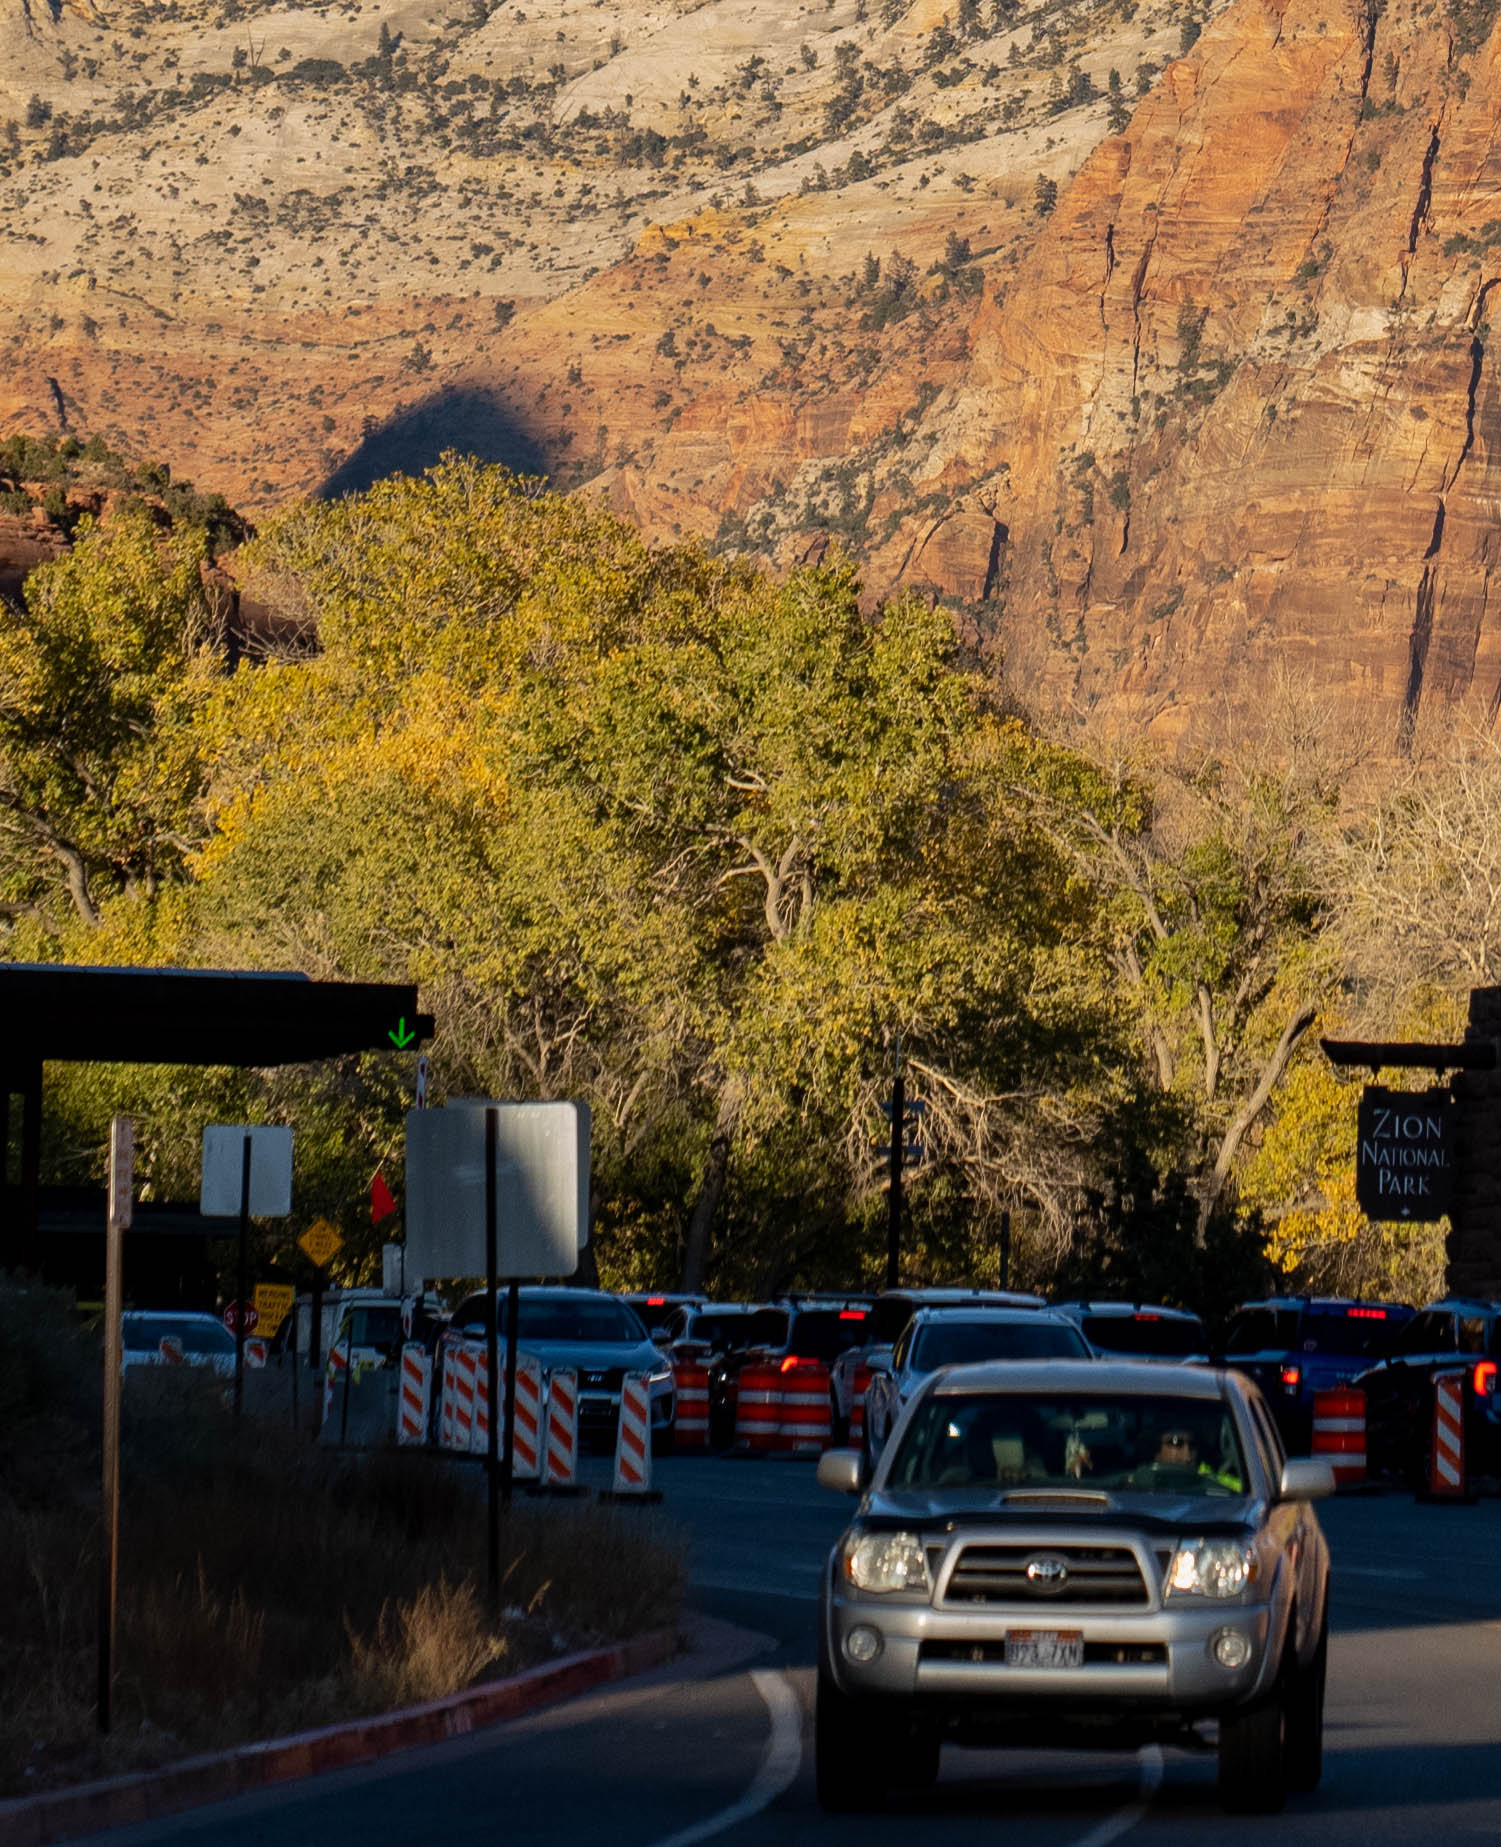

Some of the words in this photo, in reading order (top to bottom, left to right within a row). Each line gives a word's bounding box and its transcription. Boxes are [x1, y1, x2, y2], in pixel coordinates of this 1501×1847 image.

[1373, 1108, 1442, 1140] ZION
[1362, 1139, 1450, 1167] NATIONAL
[1378, 1167, 1431, 1195] PARK
[225, 1310, 259, 1326] SOP
